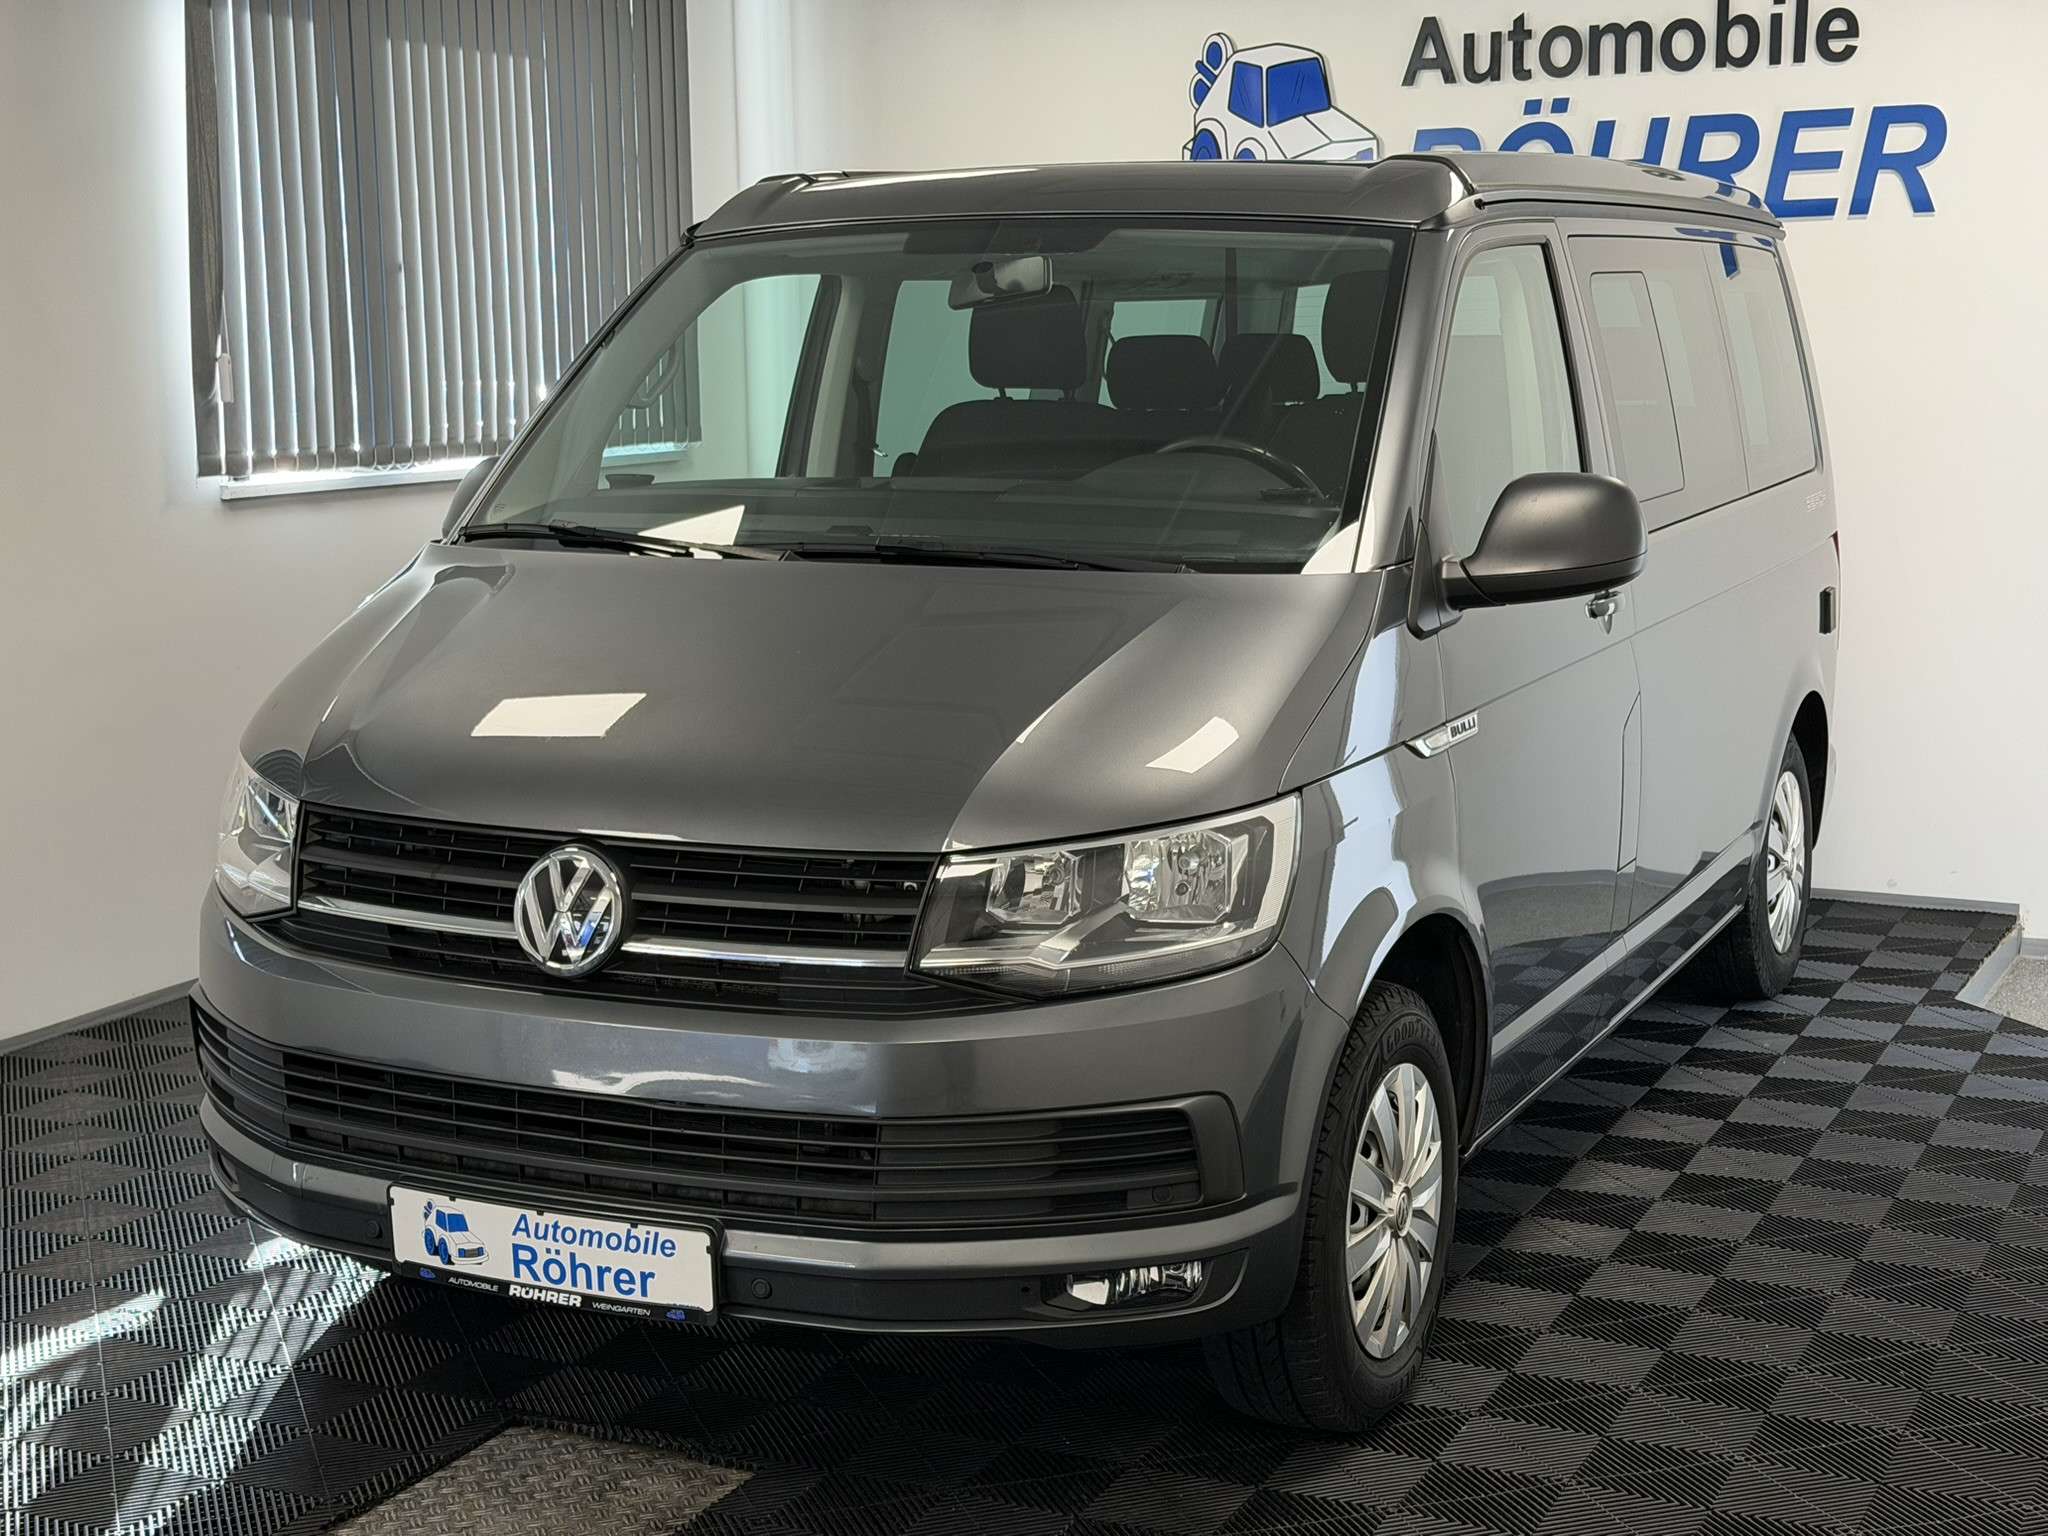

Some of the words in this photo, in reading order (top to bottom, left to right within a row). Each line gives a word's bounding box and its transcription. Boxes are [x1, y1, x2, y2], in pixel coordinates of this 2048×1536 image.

[1401, 0, 1861, 87] Automobile
[1450, 716, 1476, 738] BULLI
[511, 1213, 677, 1258] Automobile
[511, 1242, 656, 1298] Röhrer
[448, 1276, 499, 1292] AUTOMOBILE
[592, 1301, 651, 1316] WEINGARTEN
